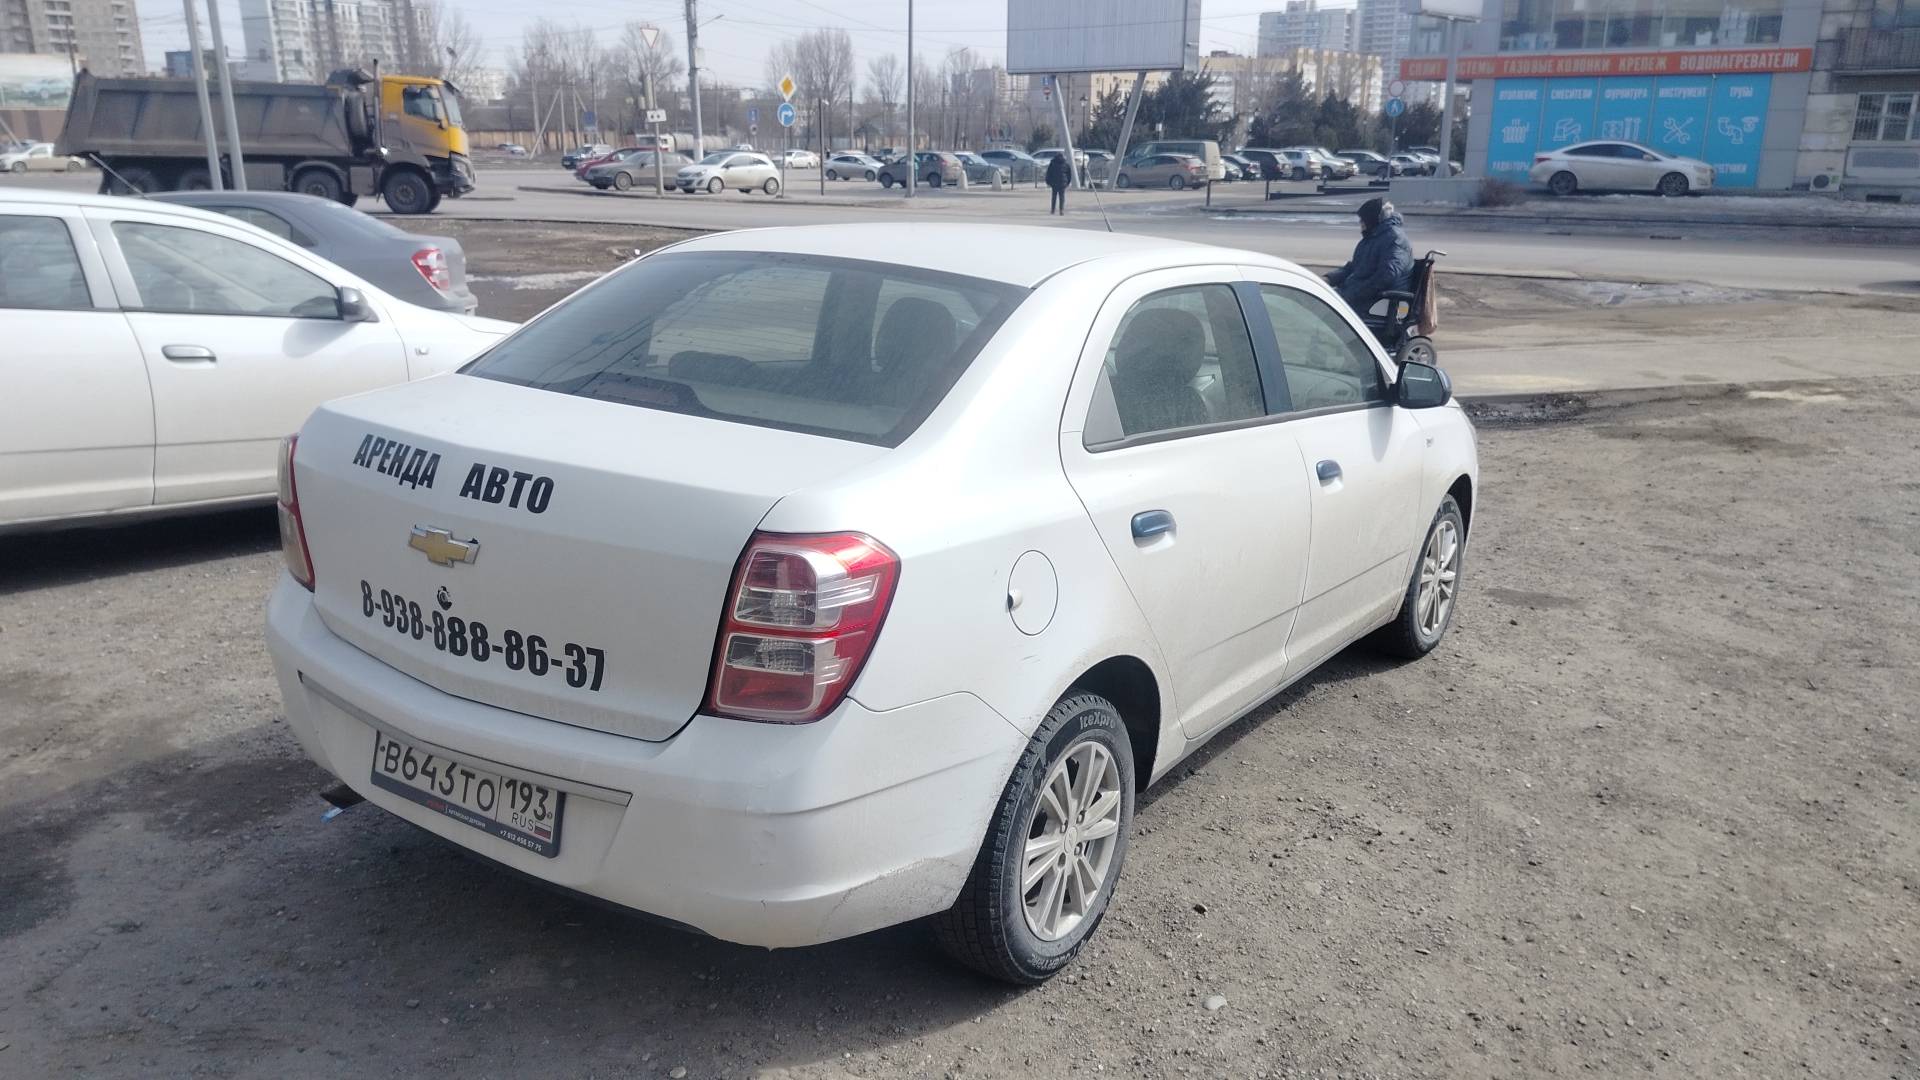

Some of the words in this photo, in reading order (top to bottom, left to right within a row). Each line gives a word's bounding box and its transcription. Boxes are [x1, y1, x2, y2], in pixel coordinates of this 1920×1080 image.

[1503, 59, 1553, 74] ГАЗОВЫЕ
[1556, 57, 1611, 72] КОЛОНКИ
[1618, 56, 1667, 72] КРЕПЕЖ
[1680, 52, 1799, 71] ВОДОНАГРЕВАТЕЛИ
[1729, 86, 1753, 99] ТРУБЫ
[353, 433, 442, 490] АРЕНДА
[459, 462, 555, 514] АВТО
[360, 579, 605, 692] 8-938-888-86-37
[505, 779, 549, 821] 193
[511, 812, 534, 831] RUS
